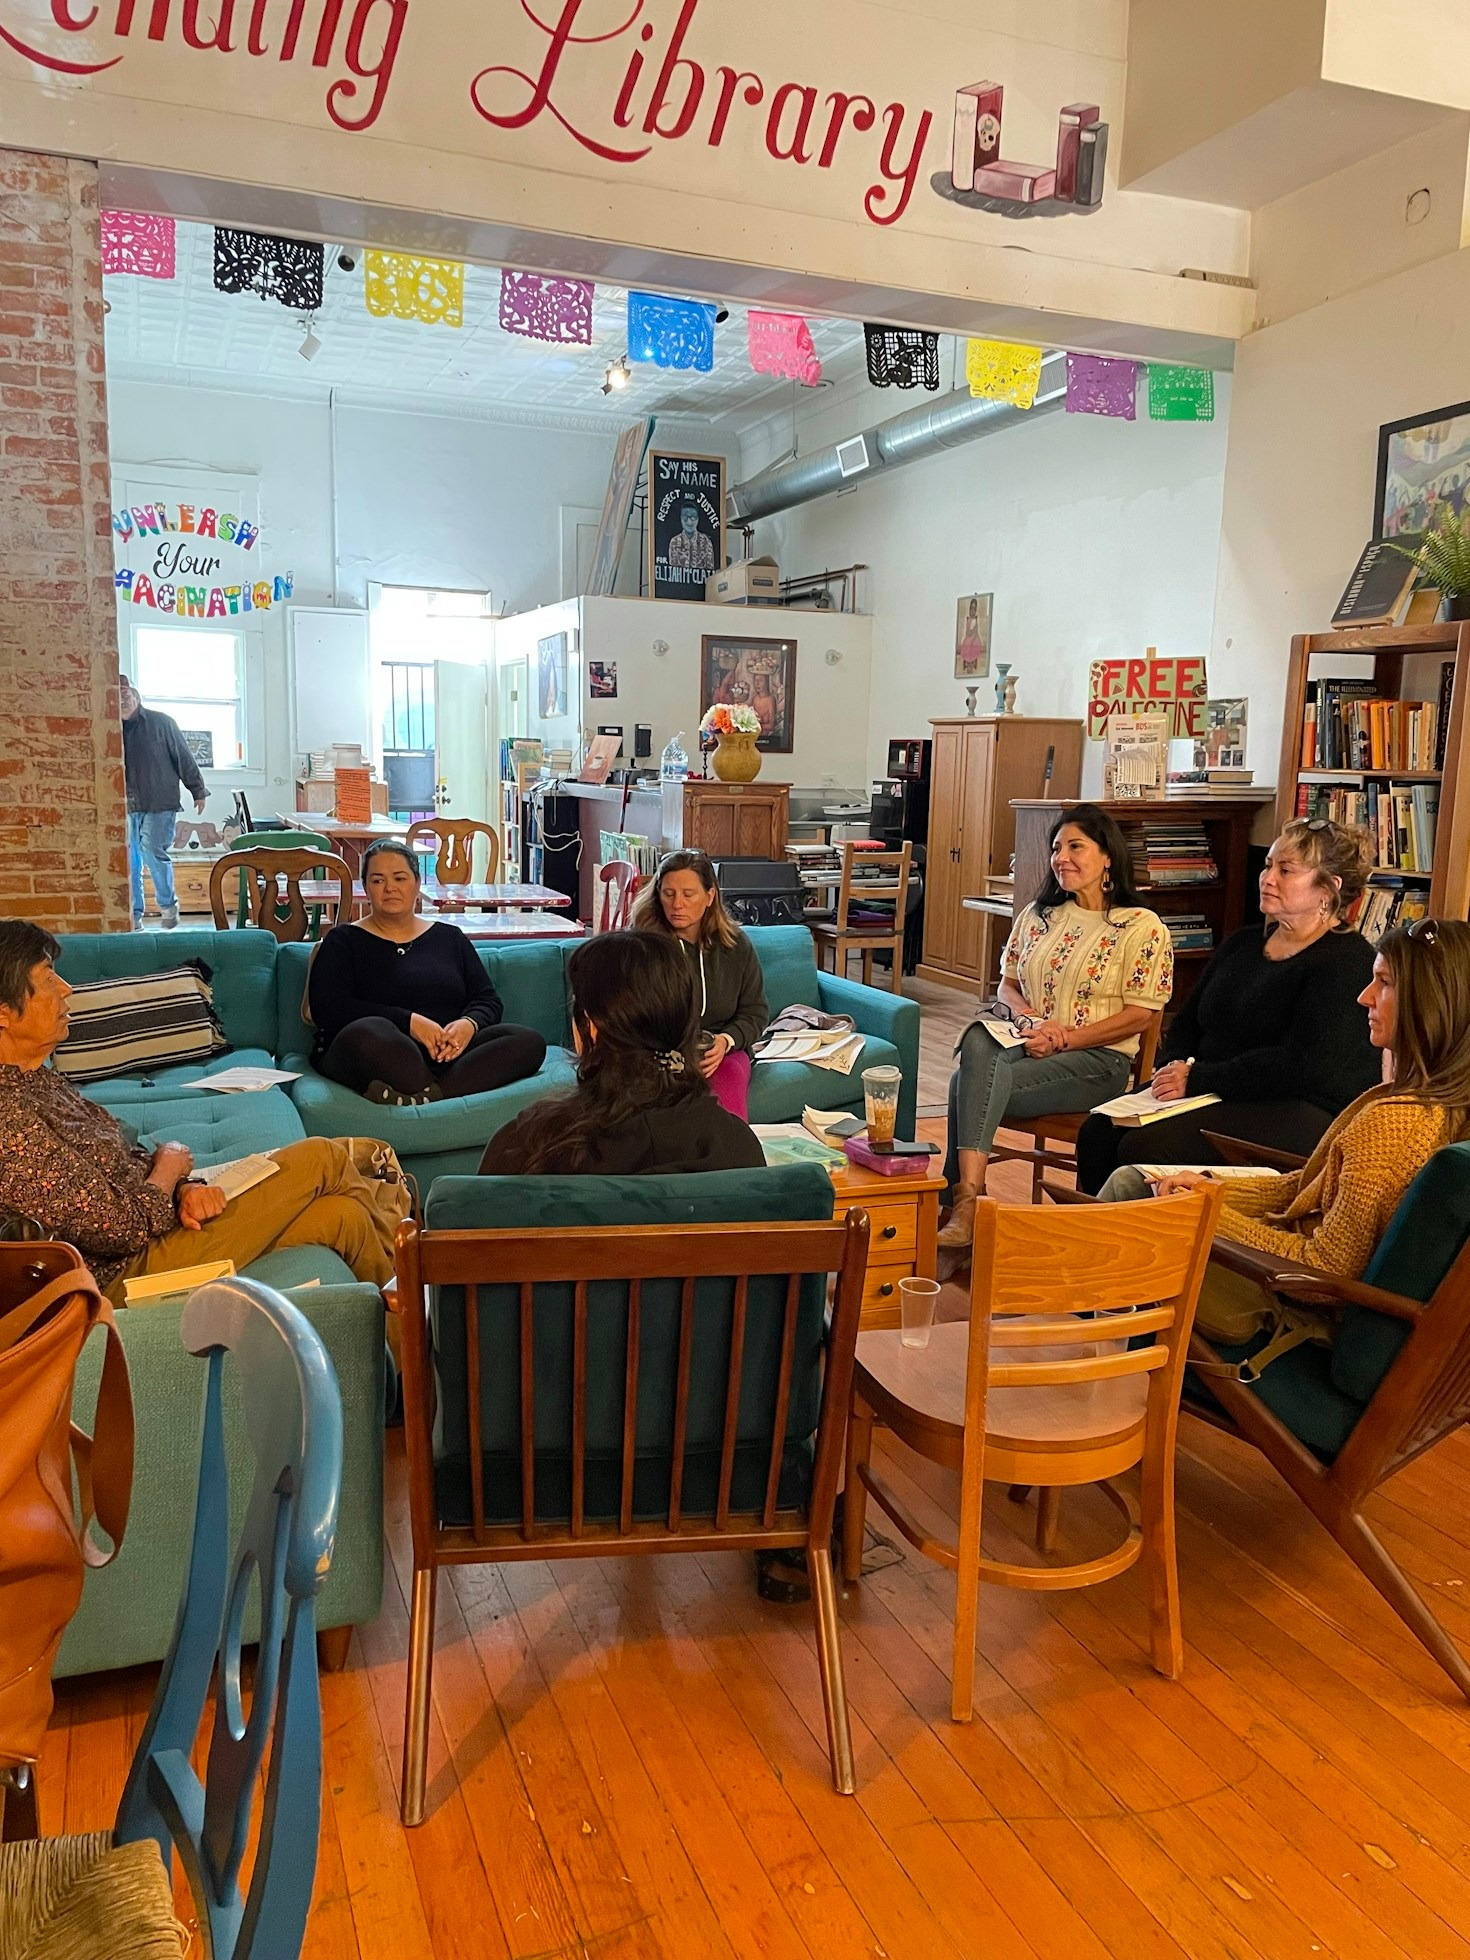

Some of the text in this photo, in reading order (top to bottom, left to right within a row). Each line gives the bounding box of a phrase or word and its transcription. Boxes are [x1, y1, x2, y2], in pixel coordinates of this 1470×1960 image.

[470, 0, 933, 226] Library
[658, 458, 698, 480] SAY HIS
[680, 473, 718, 488] NAME
[112, 502, 260, 551] UNLEASH
[656, 489, 681, 522] RESPECT
[696, 492, 720, 529] JUSTICE
[152, 542, 221, 580] Your
[655, 565, 683, 583] ELIJAH
[656, 556, 669, 565] FOR
[114, 568, 295, 618] MAGINATION
[1102, 659, 1200, 698] FREE
[1088, 700, 1206, 737] PAINE
